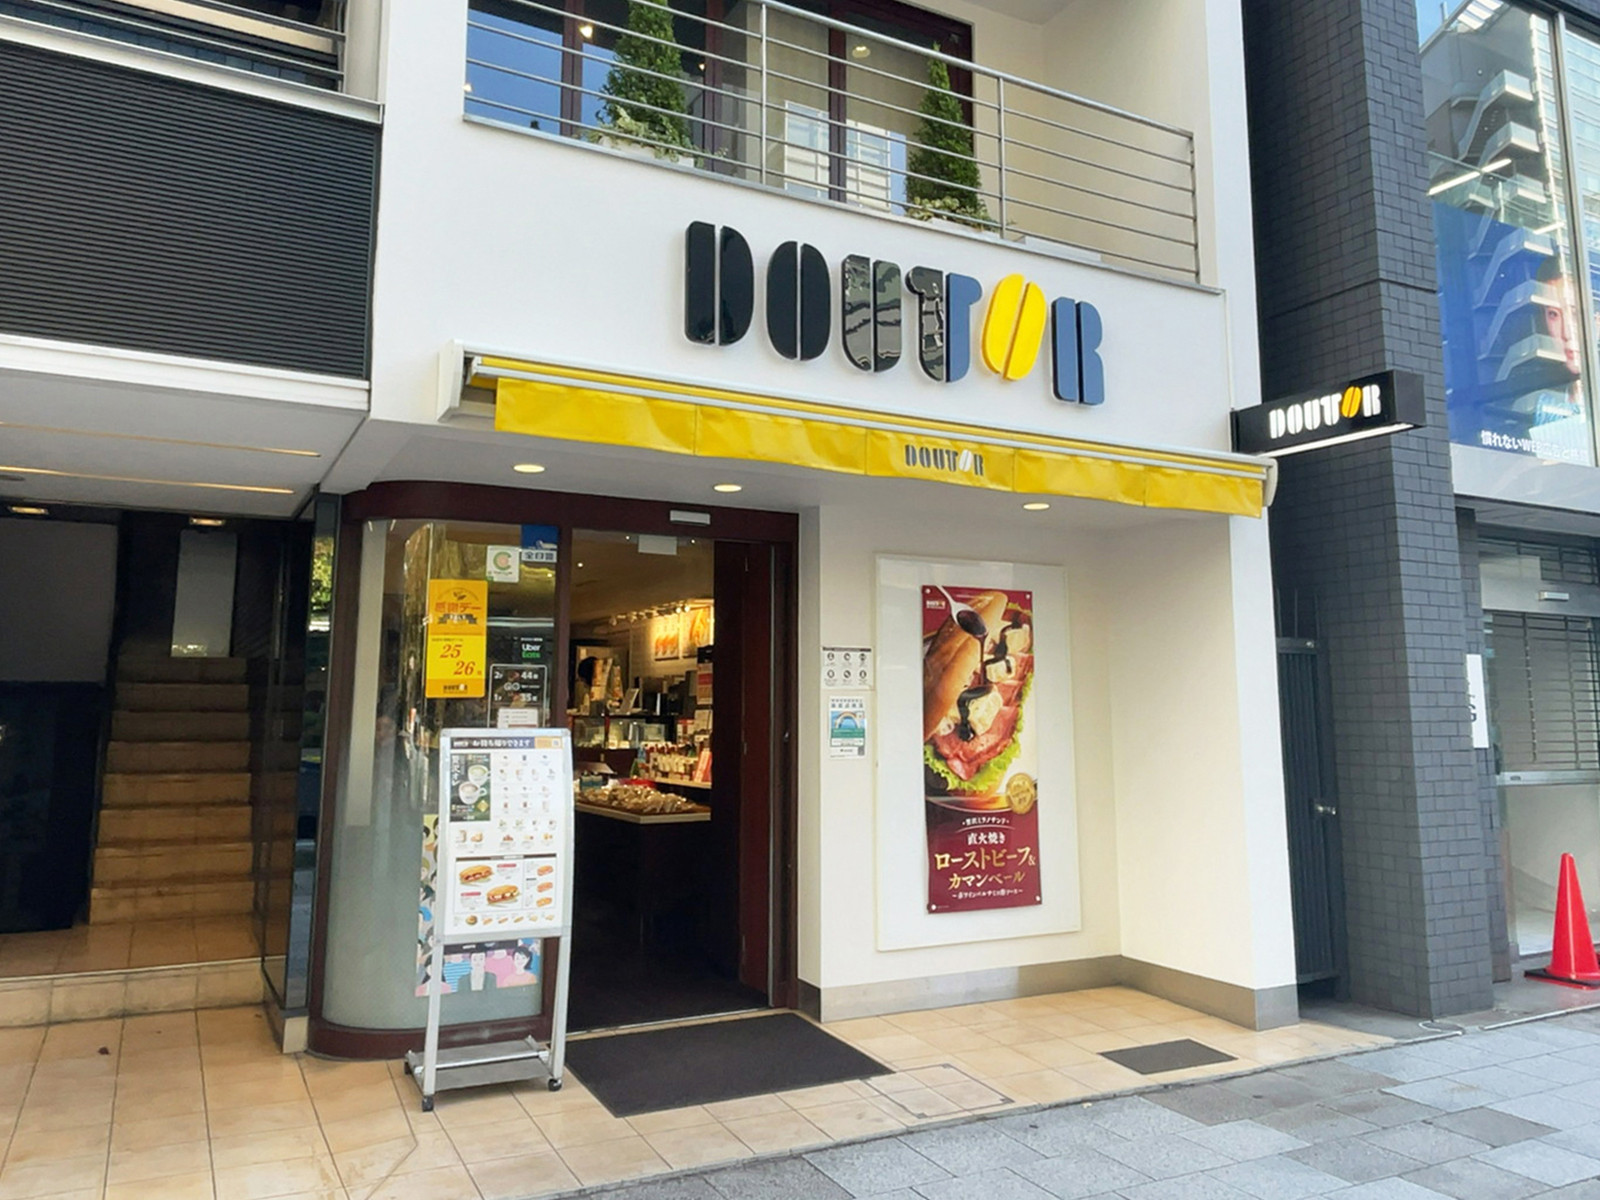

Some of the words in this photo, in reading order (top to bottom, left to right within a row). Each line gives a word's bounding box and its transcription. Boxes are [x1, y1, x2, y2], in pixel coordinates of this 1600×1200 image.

[685, 220, 1105, 406] DOUTOR
[1269, 384, 1382, 439] DOUTOR
[905, 444, 984, 476] DOUTOR
[440, 644, 463, 659] 25
[521, 643, 541, 652] Uber
[967, 832, 1006, 846] 直火焼き
[948, 871, 1026, 891] カマンベール
